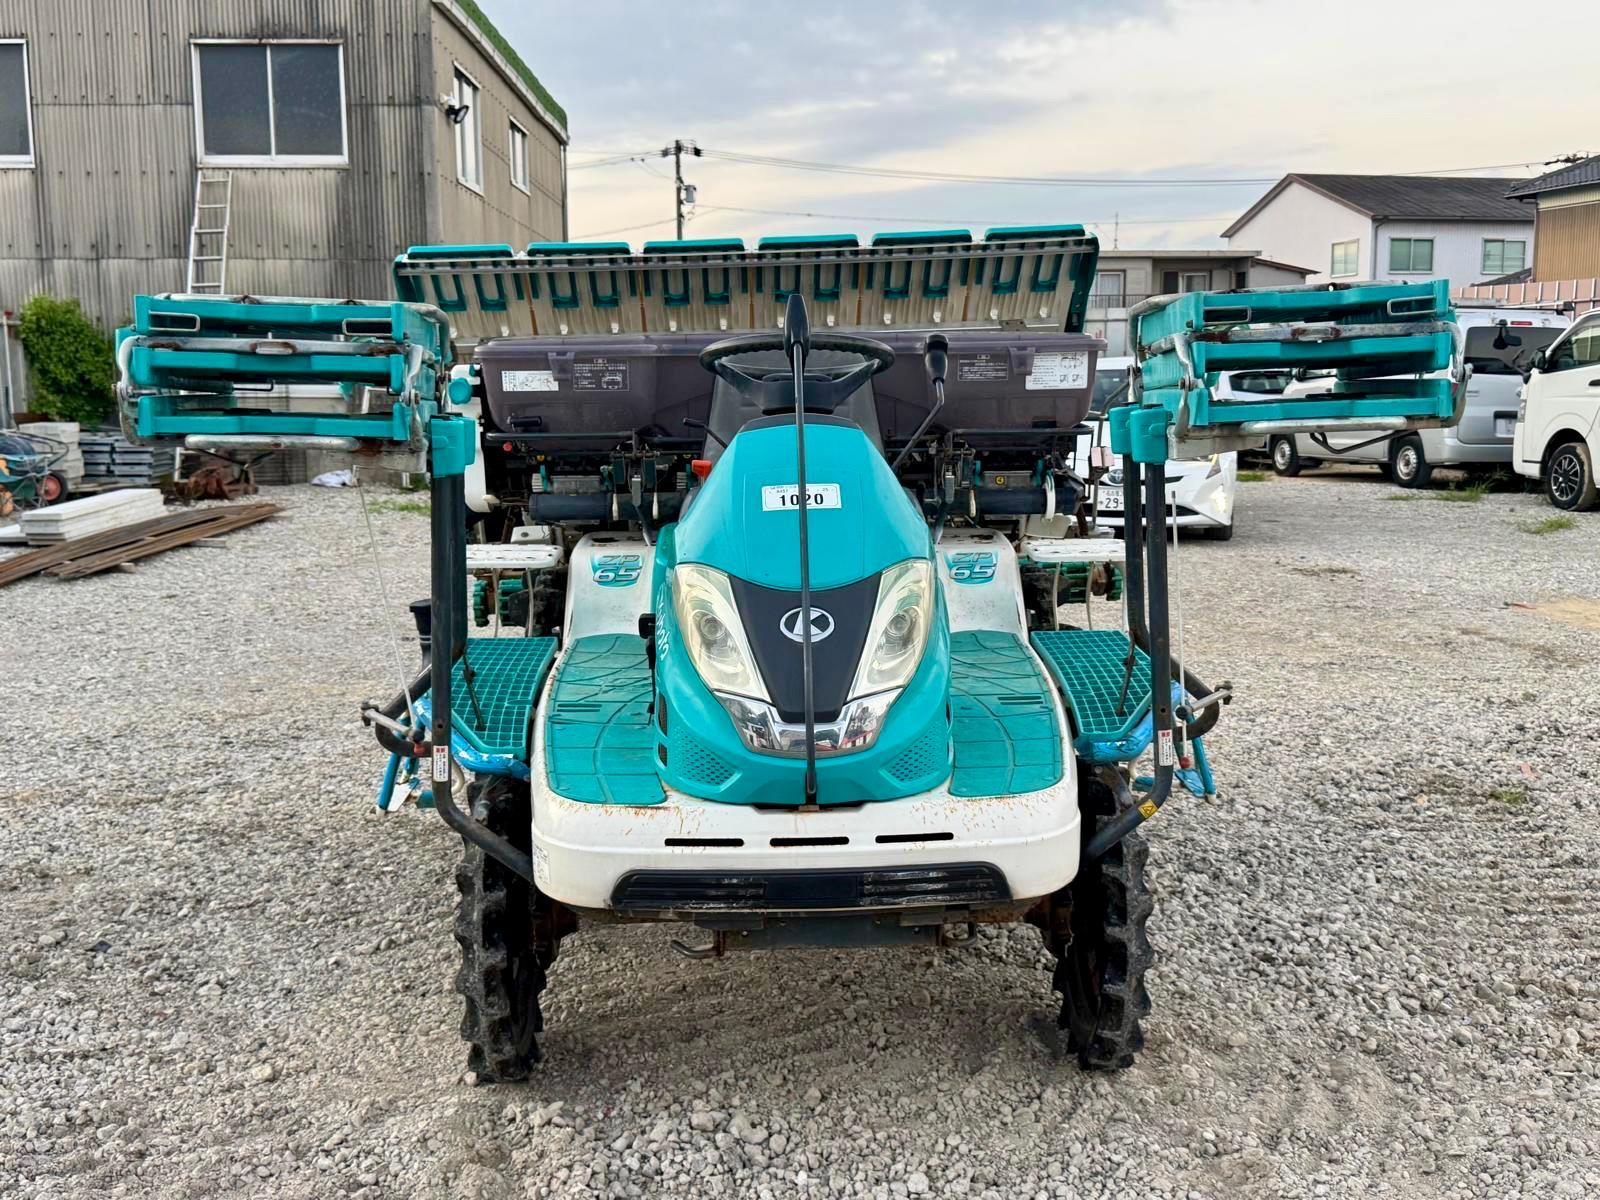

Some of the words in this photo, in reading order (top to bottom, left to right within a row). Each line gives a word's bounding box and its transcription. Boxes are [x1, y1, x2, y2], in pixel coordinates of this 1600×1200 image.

[597, 554, 641, 566] ZP
[950, 552, 993, 563] ZP
[592, 565, 643, 583] 65
[949, 562, 997, 580] 65
